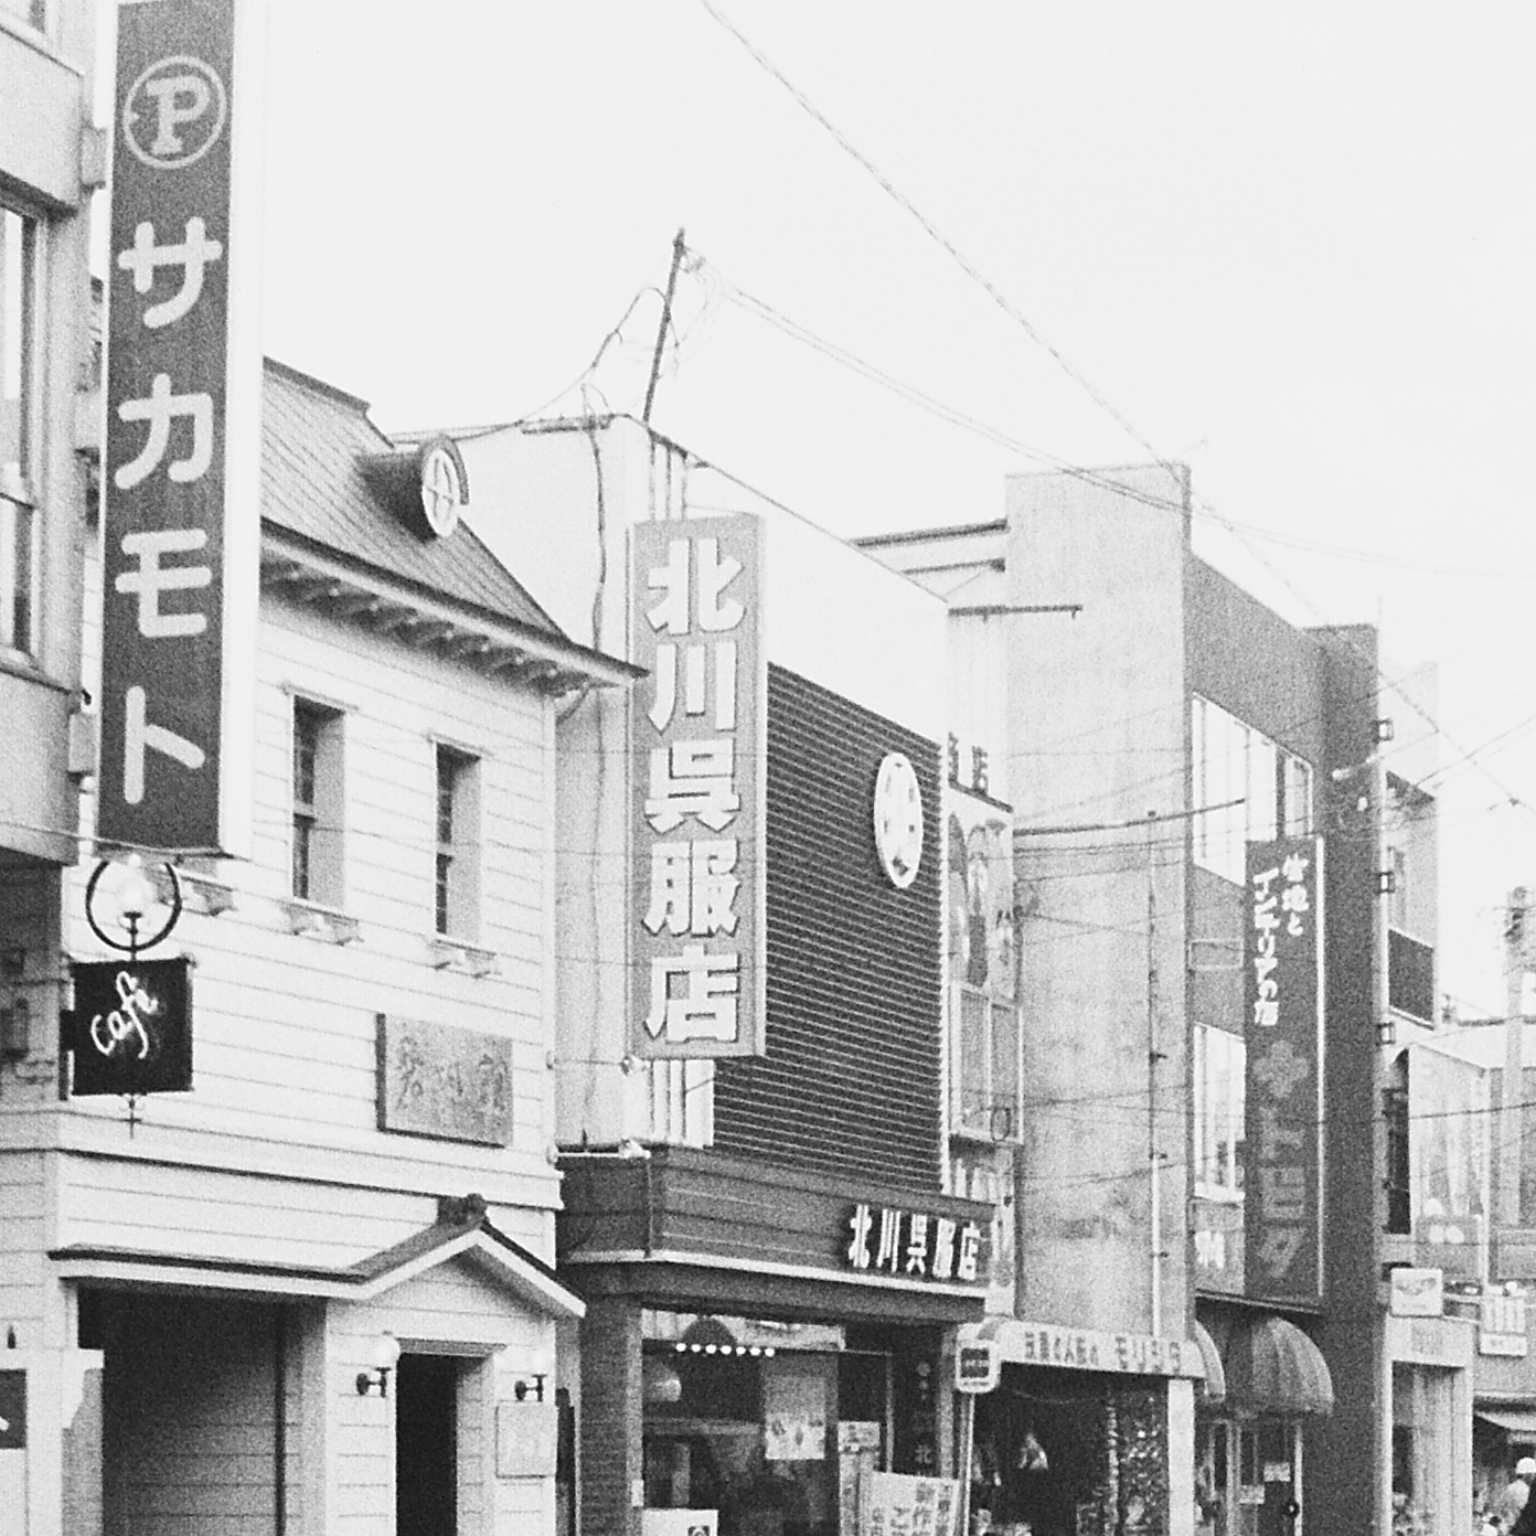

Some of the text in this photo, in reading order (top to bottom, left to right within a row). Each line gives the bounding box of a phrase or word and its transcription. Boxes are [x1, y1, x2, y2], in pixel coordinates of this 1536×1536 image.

[115, 216, 223, 805] サカモト
[642, 536, 748, 1045] 北川呉服店
[847, 1203, 982, 1281] 北川呉服店
